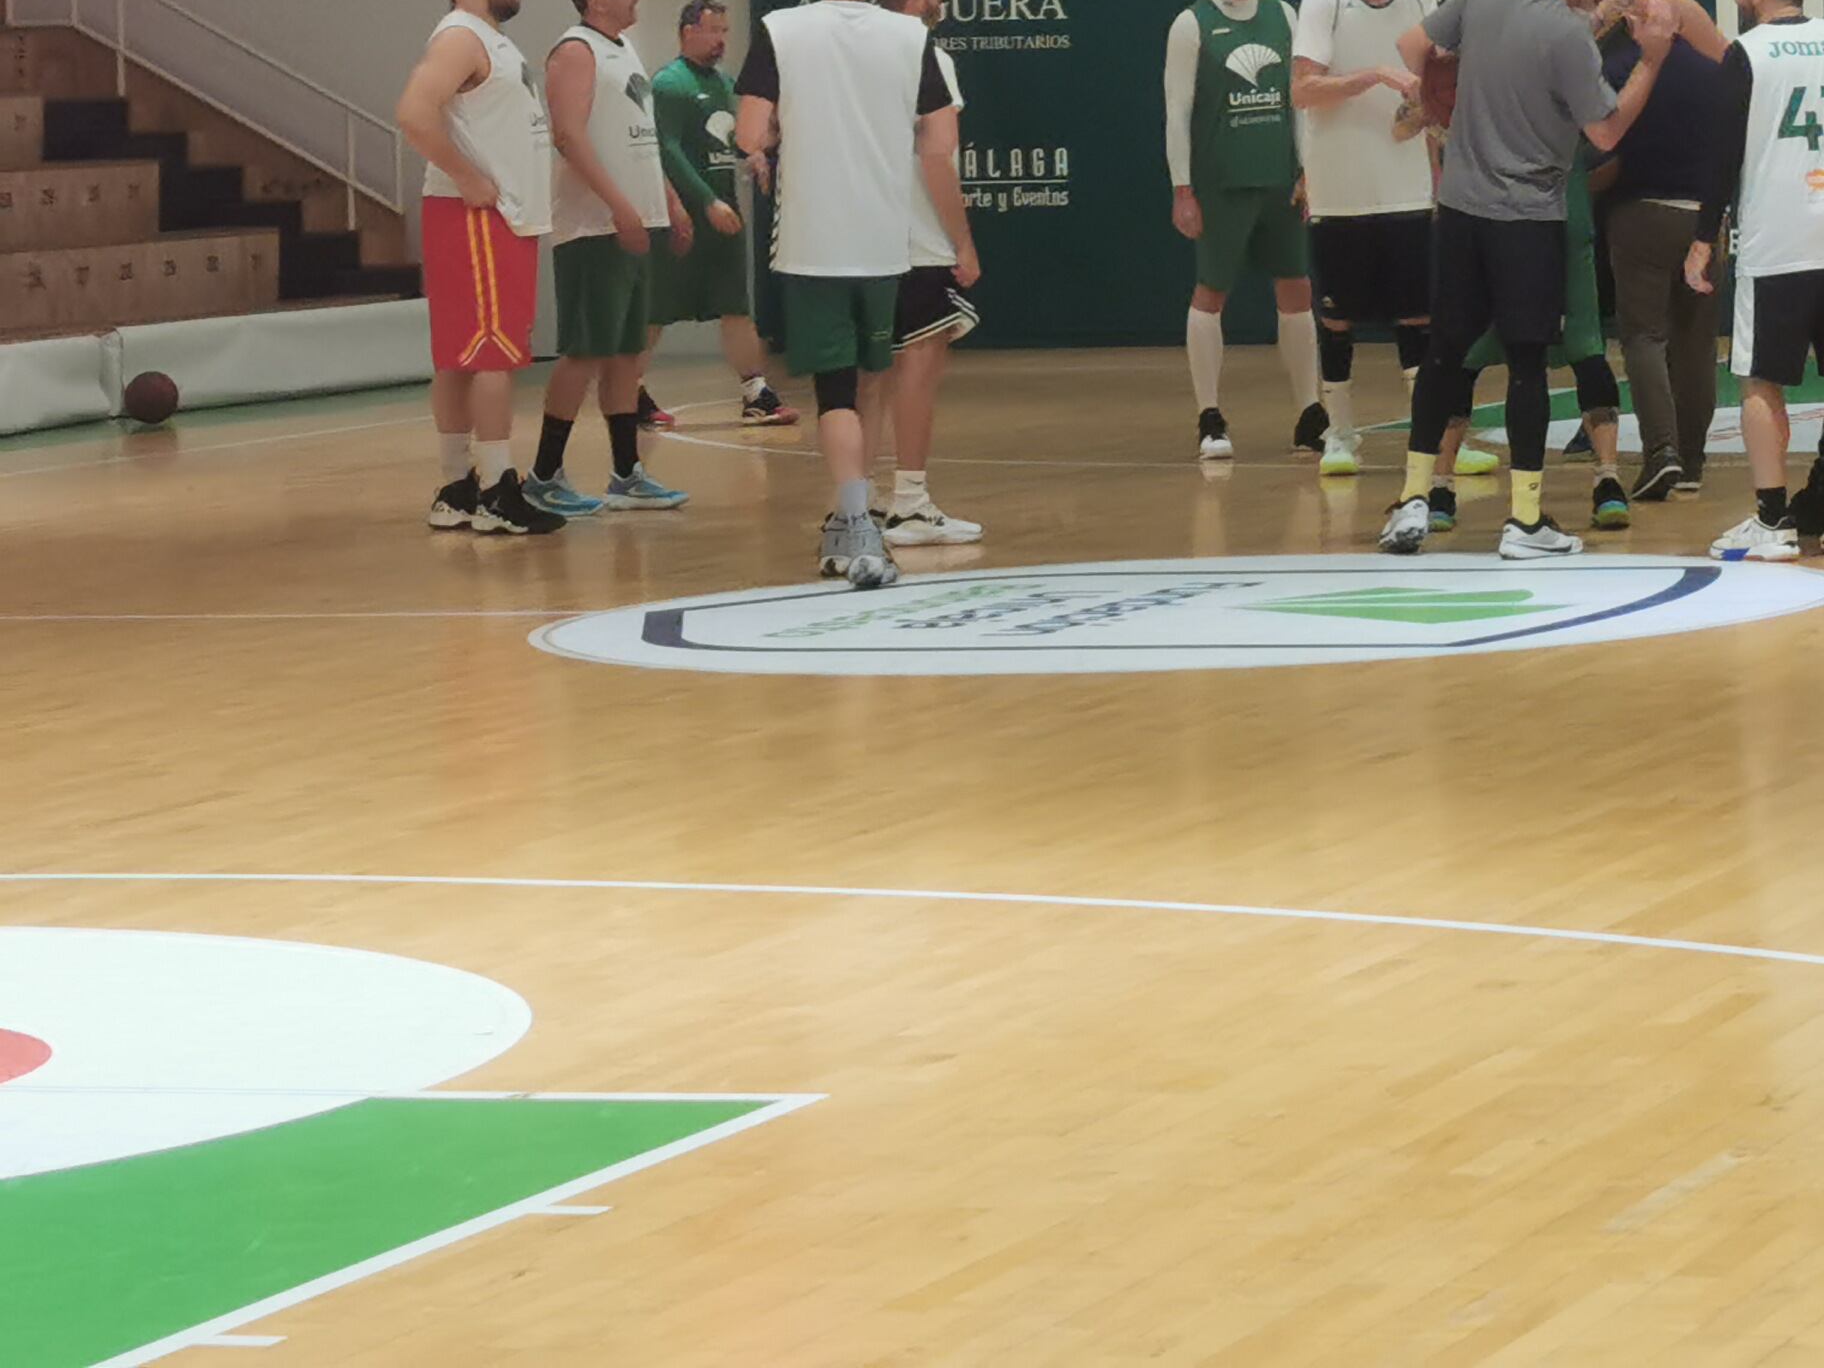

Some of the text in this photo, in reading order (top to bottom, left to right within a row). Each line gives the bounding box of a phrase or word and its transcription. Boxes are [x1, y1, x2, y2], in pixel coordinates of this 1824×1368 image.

[970, 34, 1071, 50] TRIBUTARIOS
[963, 142, 1070, 179] ÁLAGA
[1012, 186, 1070, 207] Eventos
